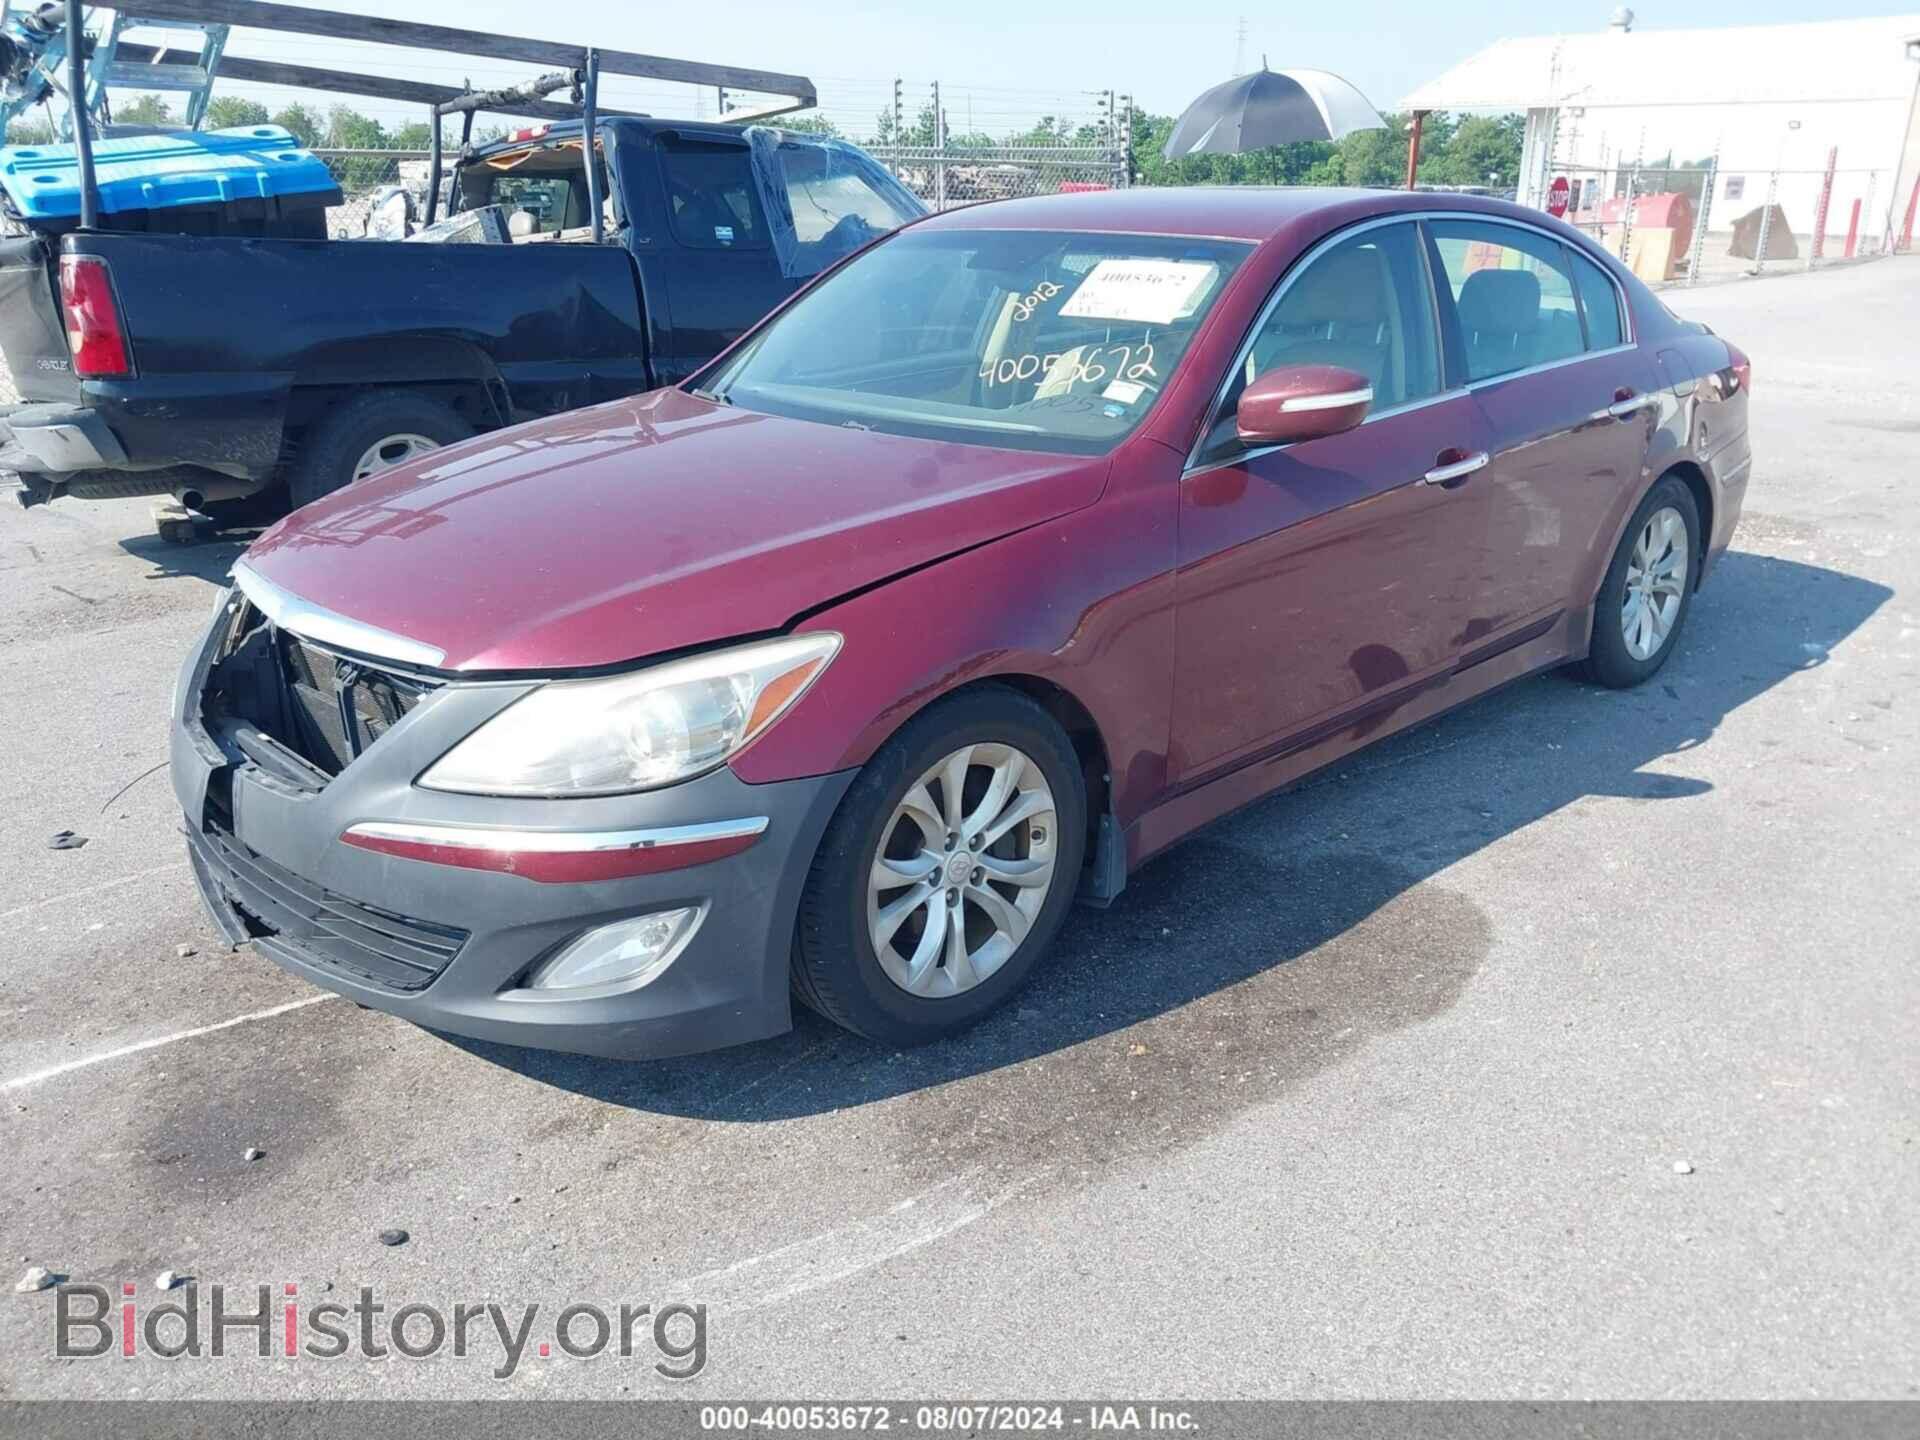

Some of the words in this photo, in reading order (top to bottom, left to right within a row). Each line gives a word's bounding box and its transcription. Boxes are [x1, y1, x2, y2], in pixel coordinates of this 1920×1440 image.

[1549, 190, 1569, 208] STOP
[1014, 281, 1065, 321] 2012
[979, 344, 1157, 394] 40053672
